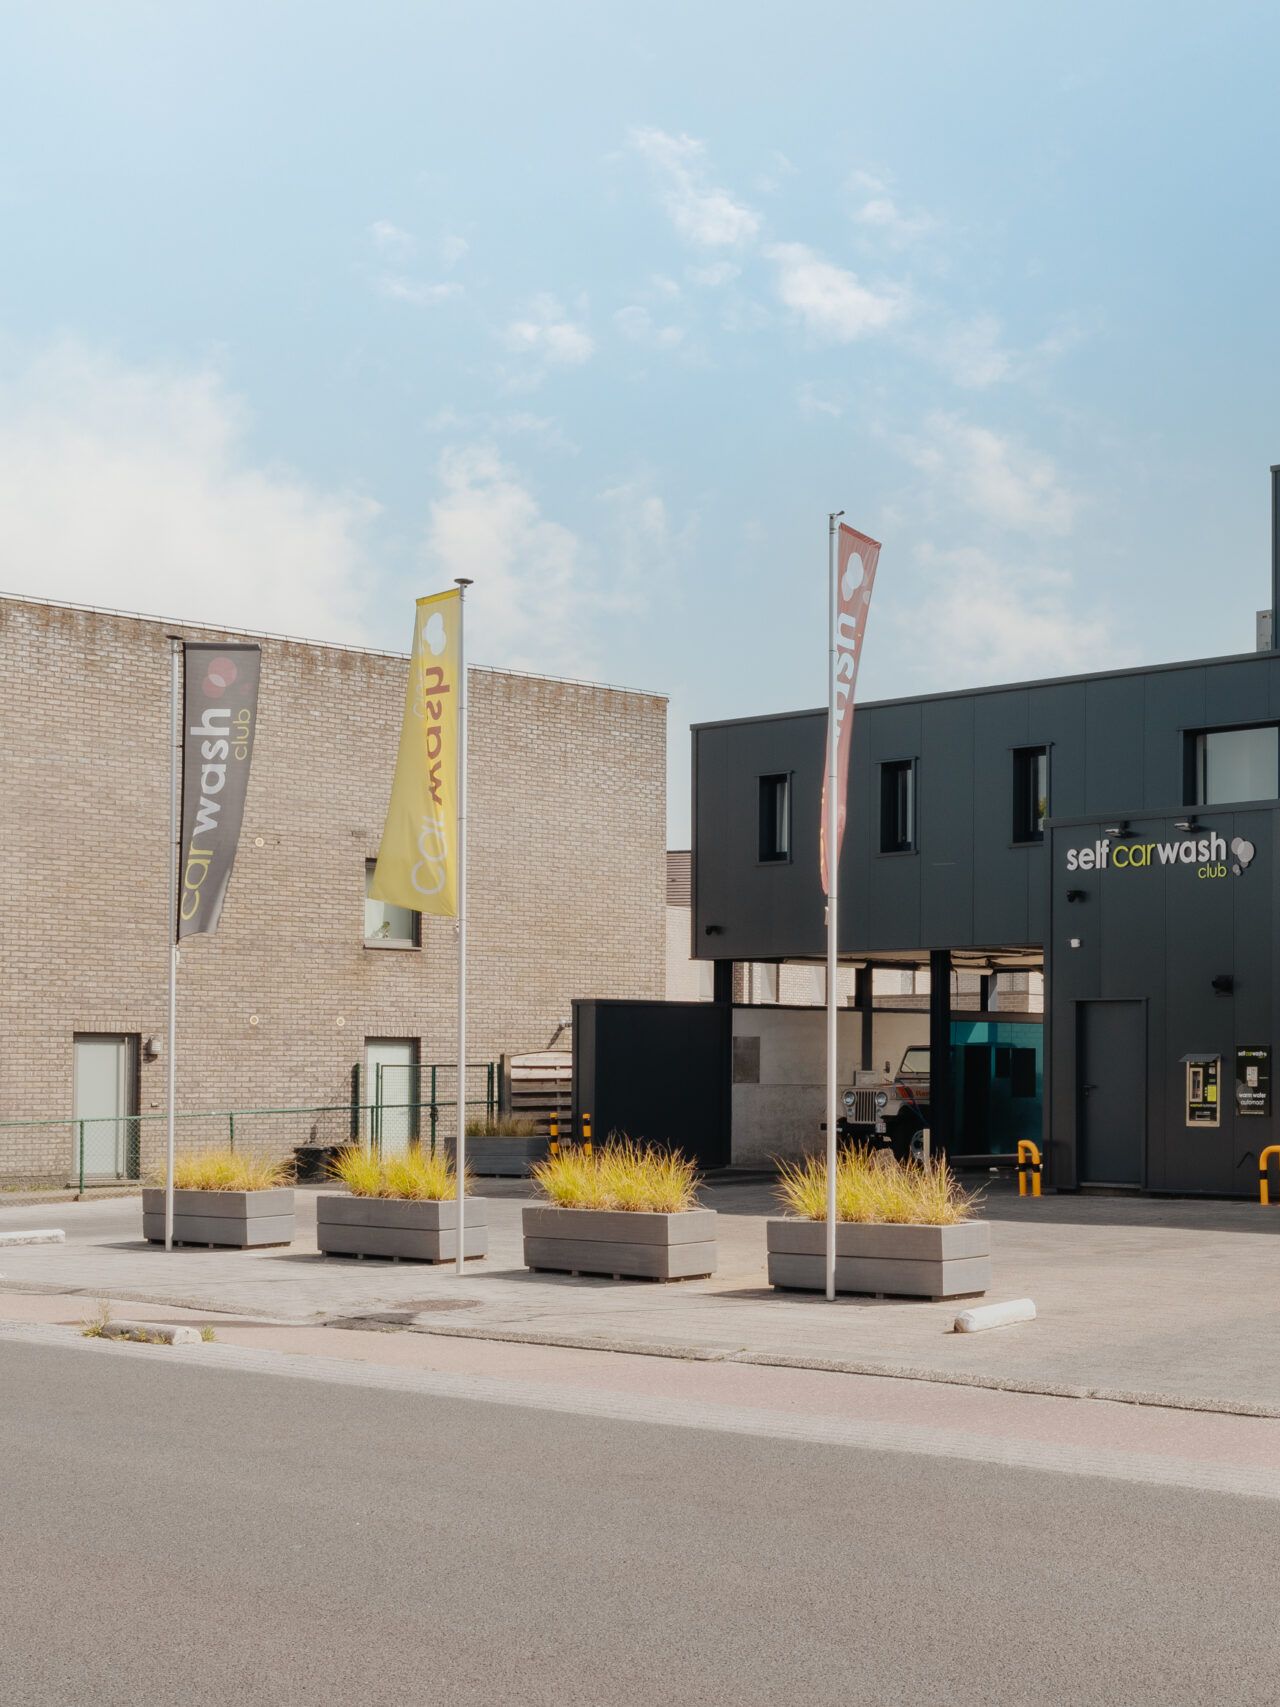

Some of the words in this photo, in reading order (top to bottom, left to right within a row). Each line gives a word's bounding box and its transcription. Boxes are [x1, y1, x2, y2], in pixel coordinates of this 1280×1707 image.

[231, 708, 251, 761] club
[1066, 839, 1110, 871] self
[1198, 863, 1227, 879] club
